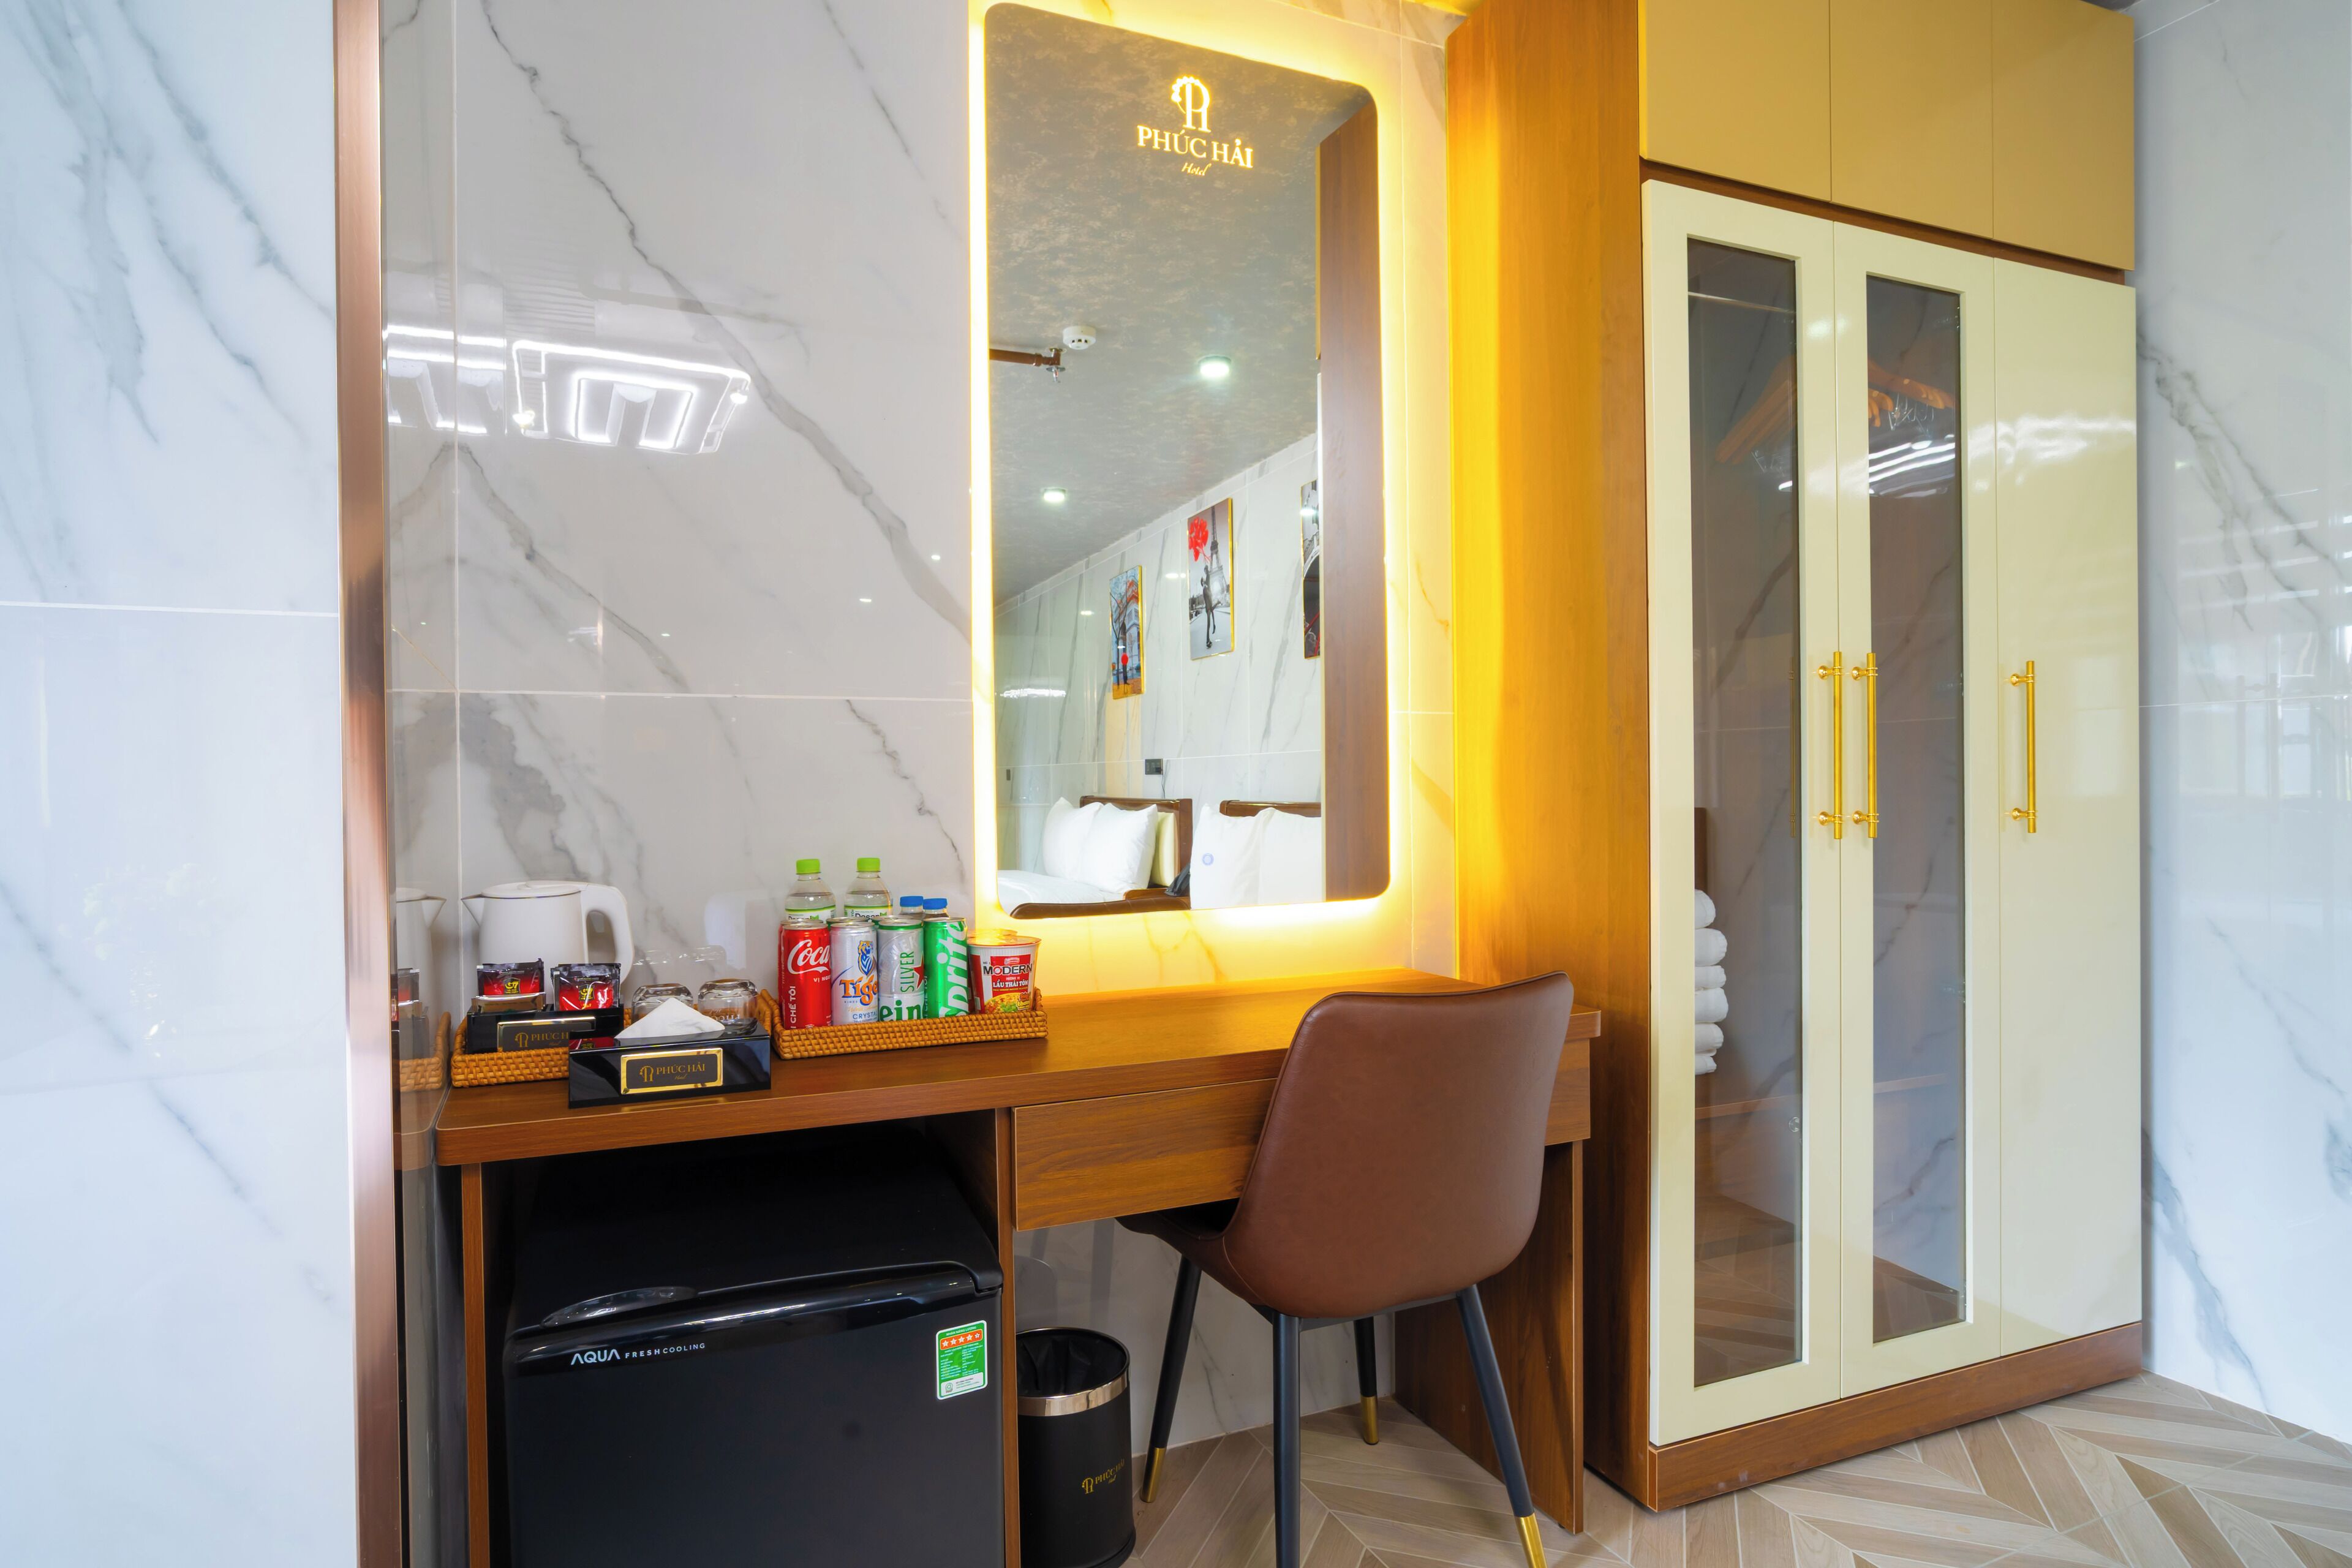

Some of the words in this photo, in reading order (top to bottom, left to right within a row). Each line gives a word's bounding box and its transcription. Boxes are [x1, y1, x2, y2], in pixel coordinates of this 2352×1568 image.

[1137, 125, 1207, 158] PHÚC
[1211, 138, 1254, 168] HẢI
[1181, 162, 1212, 176] Hotel
[900, 951, 914, 993] SILVER
[983, 963, 1033, 976] MODERN
[656, 1065, 686, 1076] PHÚC
[687, 1063, 706, 1072] HẢI
[570, 1349, 620, 1365] AQUA
